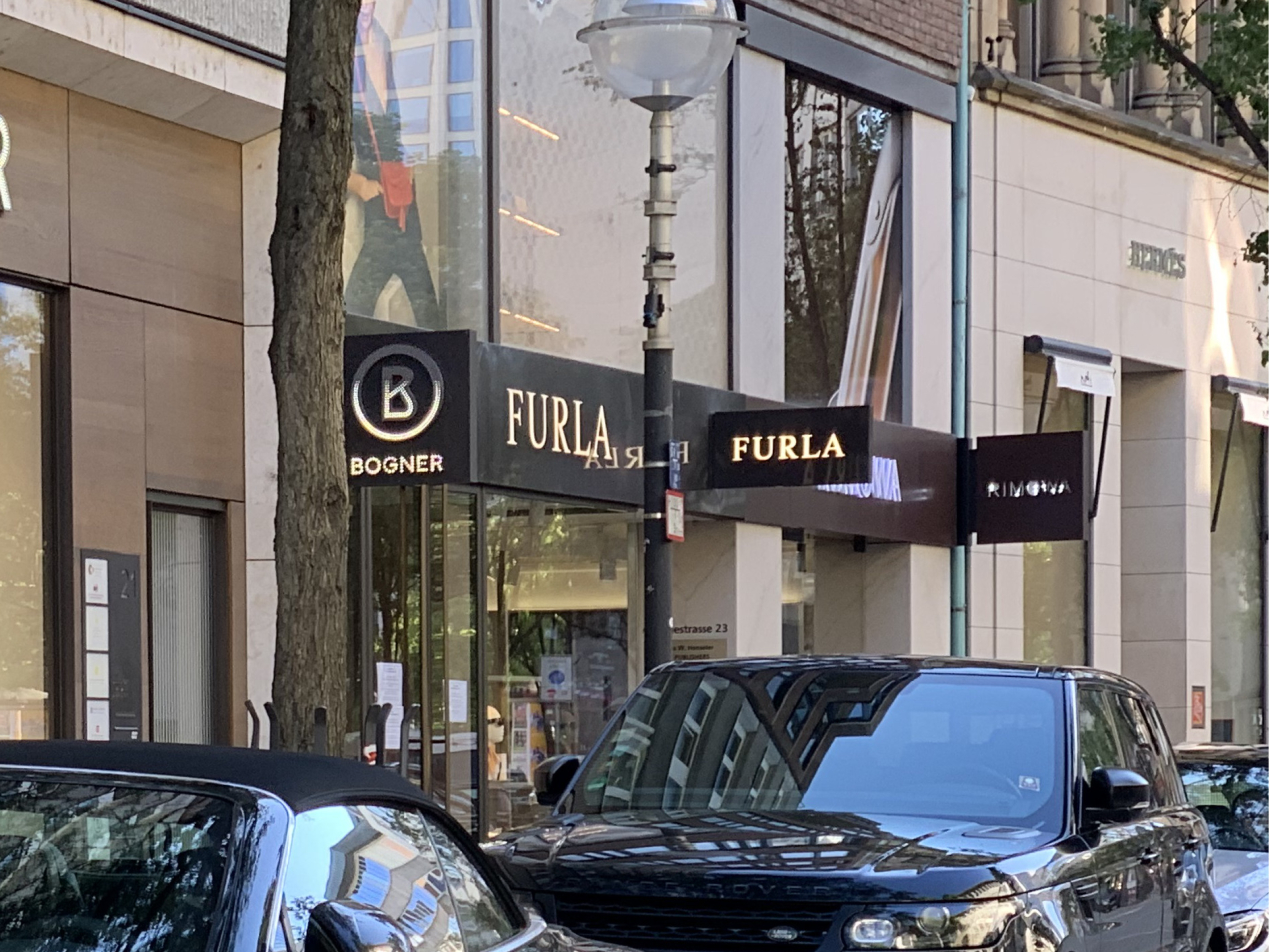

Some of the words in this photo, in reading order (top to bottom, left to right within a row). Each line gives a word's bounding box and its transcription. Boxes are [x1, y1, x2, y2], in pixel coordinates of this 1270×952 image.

[506, 387, 612, 460] FURLA
[732, 432, 846, 463] FURLA
[350, 454, 444, 476] BOGNER
[986, 480, 1072, 498] RIMOWA
[673, 625, 713, 634] estrasse
[715, 623, 728, 633] 23
